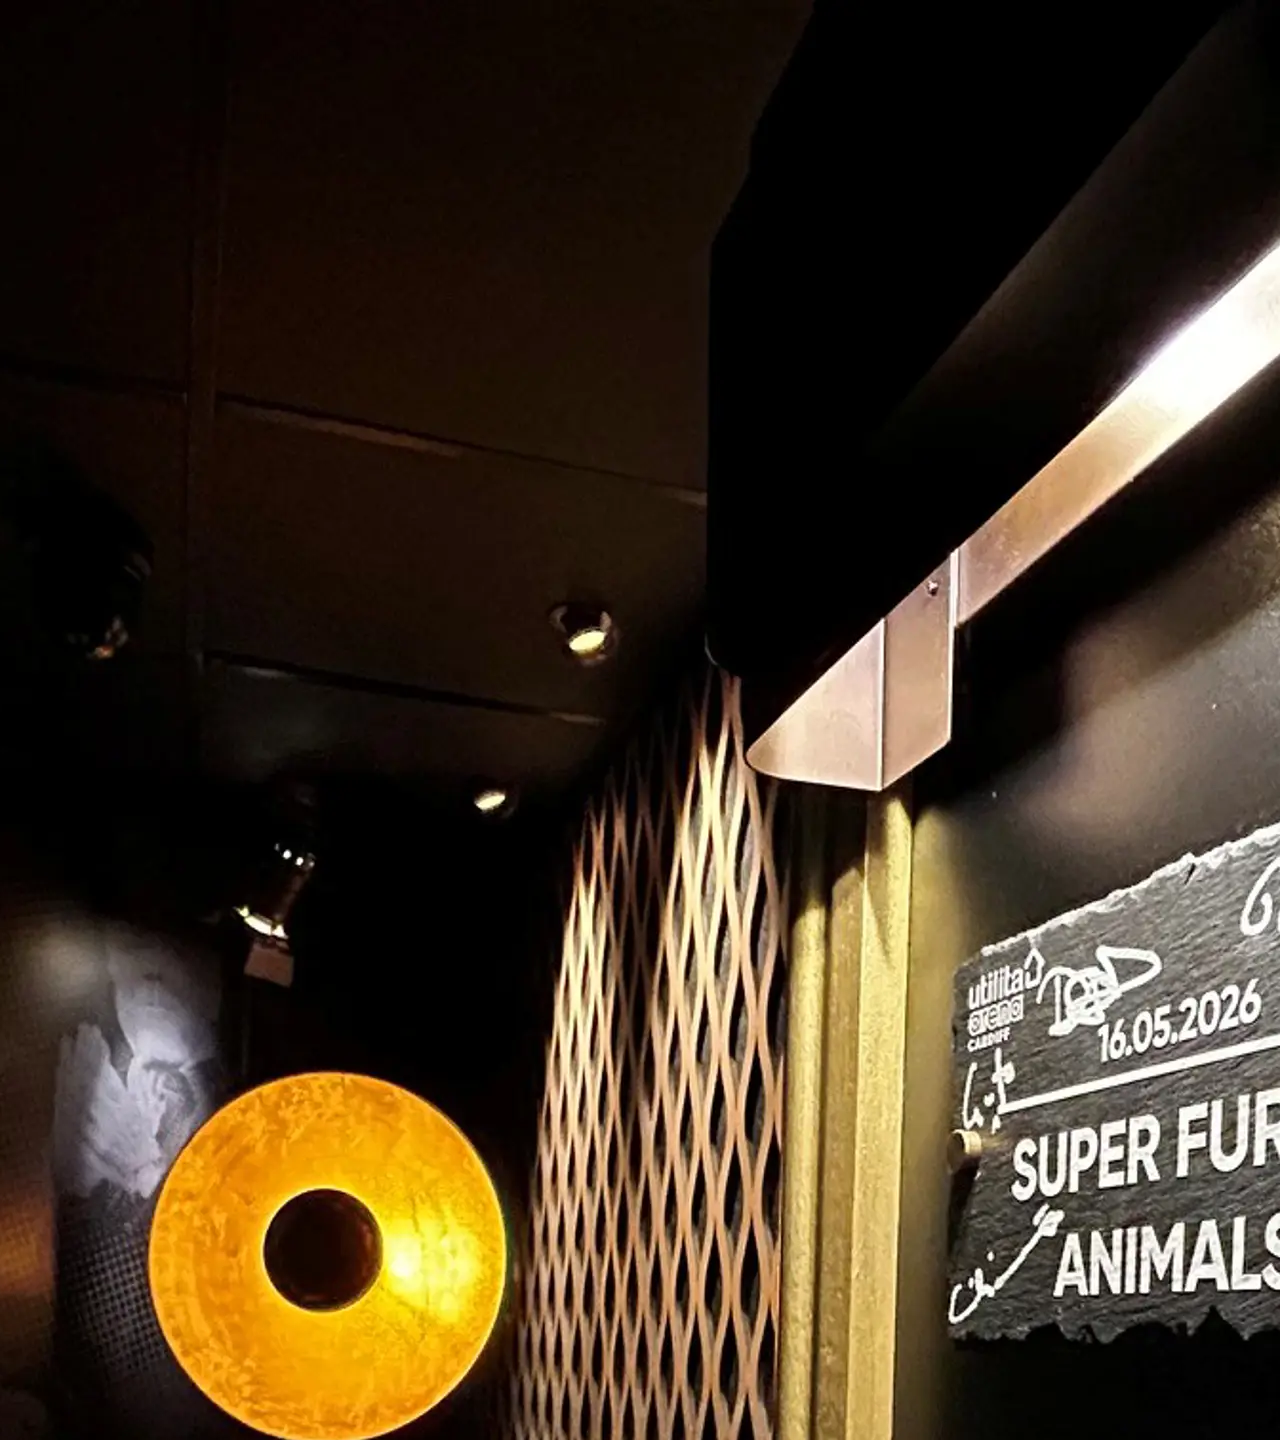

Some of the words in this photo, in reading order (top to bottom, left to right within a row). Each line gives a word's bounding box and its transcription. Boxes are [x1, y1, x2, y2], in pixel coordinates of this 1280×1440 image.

[968, 964, 1024, 1010] utilita
[1097, 978, 1262, 1064] 16.05.2026
[1010, 1113, 1161, 1203] SUPER
